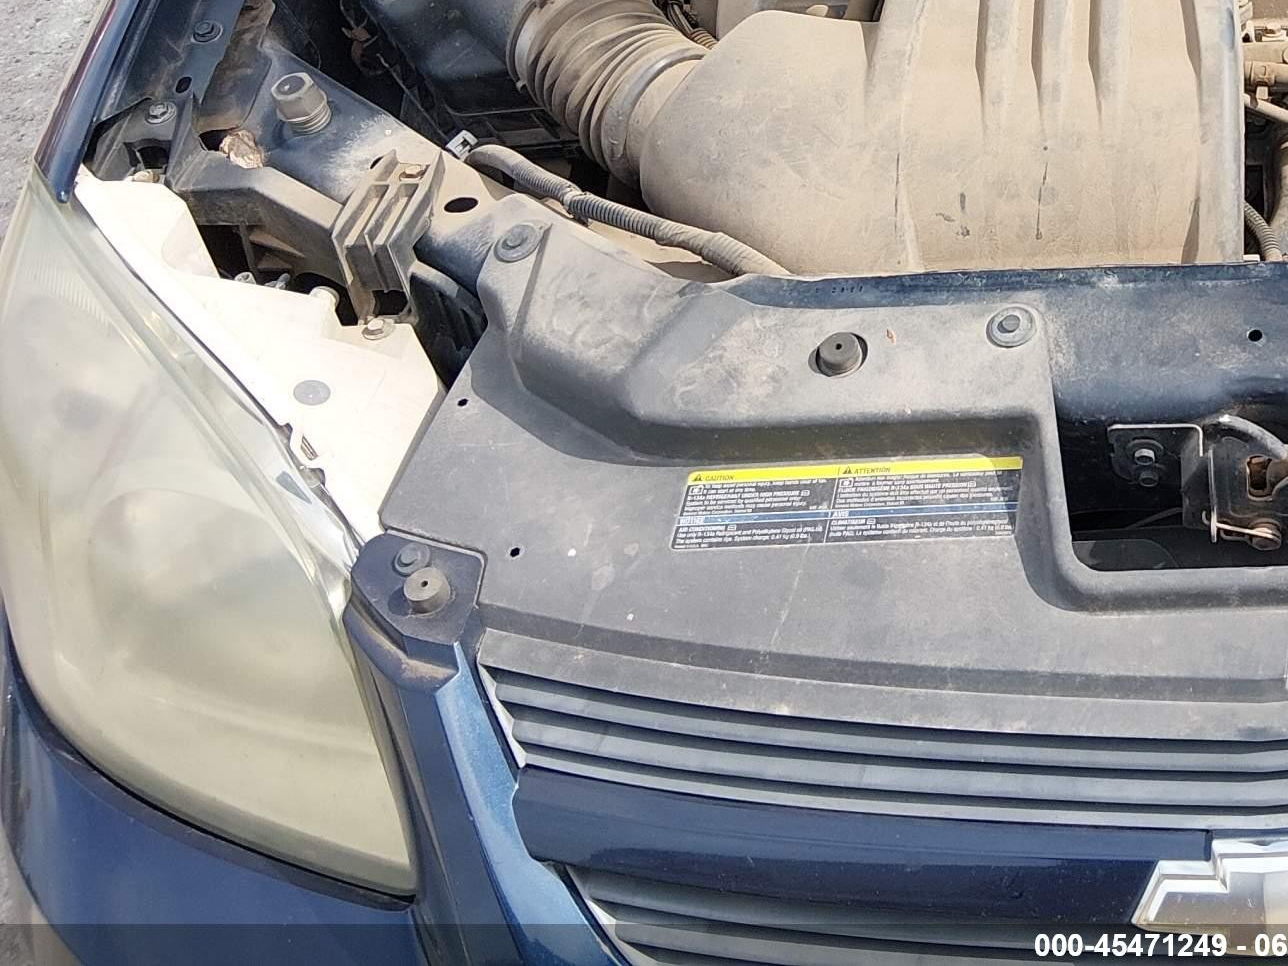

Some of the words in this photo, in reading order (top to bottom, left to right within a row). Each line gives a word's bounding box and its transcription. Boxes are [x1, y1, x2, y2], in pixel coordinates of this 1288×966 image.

[853, 466, 891, 475] ATTENTION
[704, 474, 734, 482] CAUTION
[832, 510, 850, 518] AVIS
